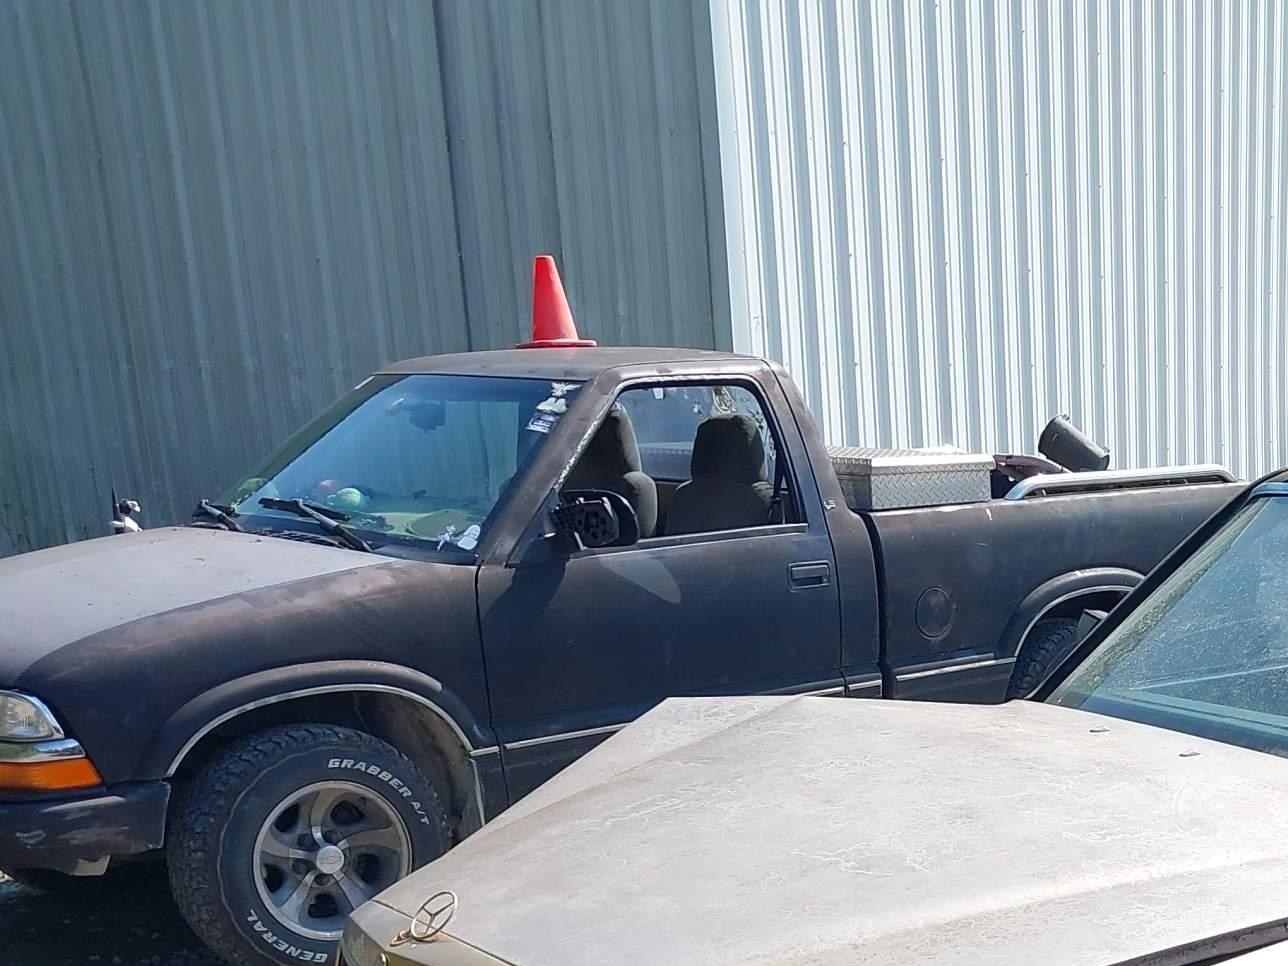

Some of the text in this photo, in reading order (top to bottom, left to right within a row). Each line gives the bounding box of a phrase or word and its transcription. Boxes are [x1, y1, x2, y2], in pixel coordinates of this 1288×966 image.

[328, 757, 430, 826] GRABBER A/T
[247, 909, 329, 964] GENERAL
